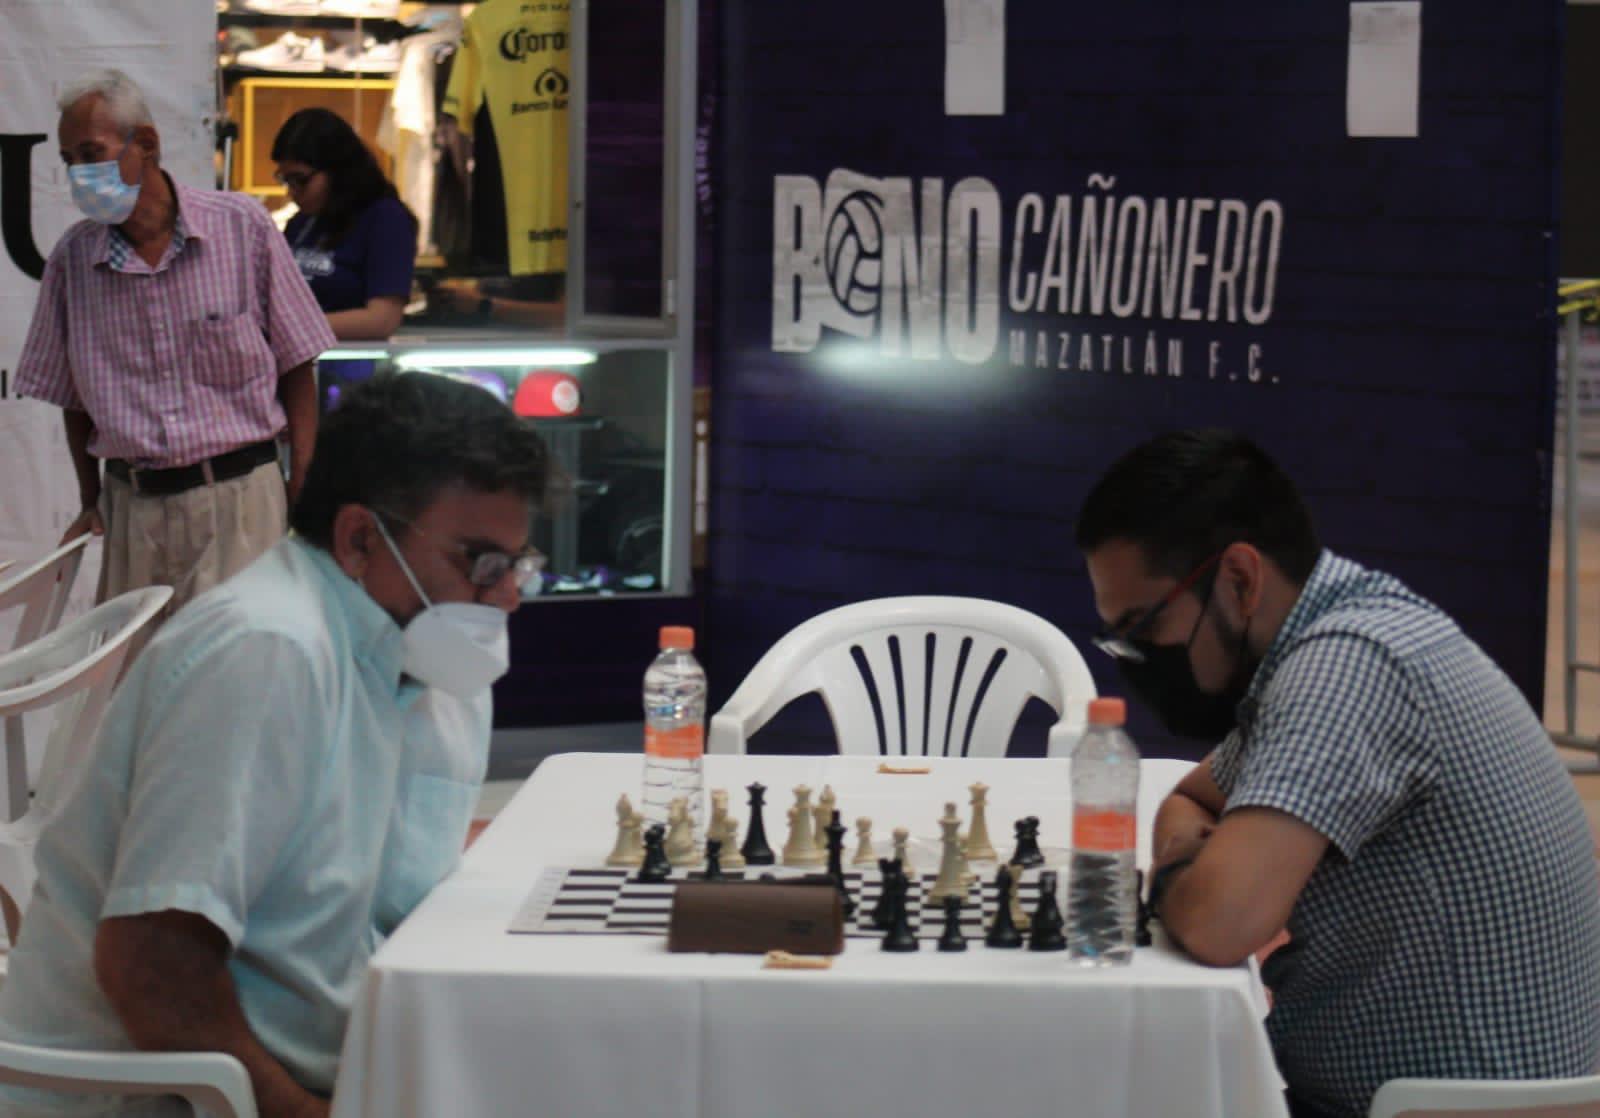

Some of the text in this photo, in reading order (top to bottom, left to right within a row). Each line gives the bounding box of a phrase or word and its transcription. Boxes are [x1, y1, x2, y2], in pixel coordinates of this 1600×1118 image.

[771, 167, 1284, 365] BONO CAÑONERO
[1008, 328, 1184, 377] MAZATLÁN
